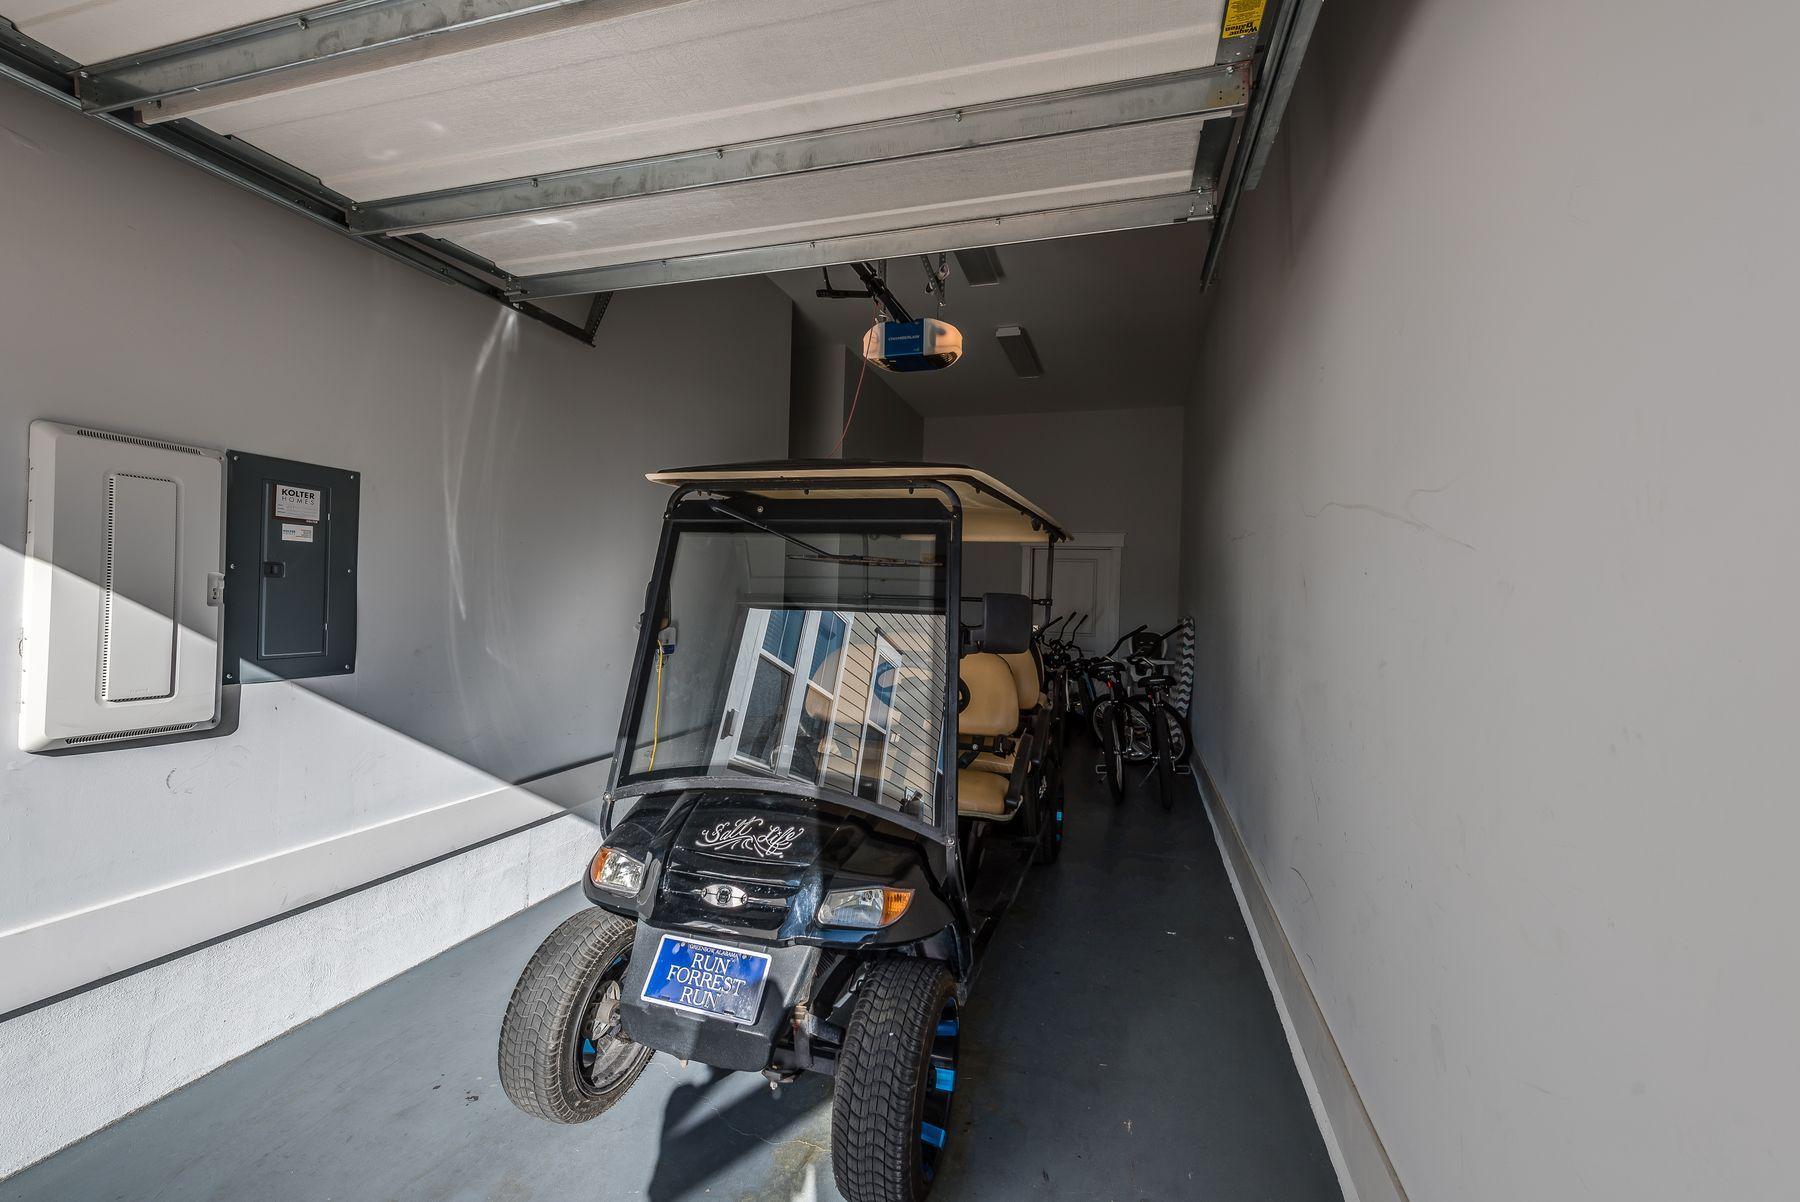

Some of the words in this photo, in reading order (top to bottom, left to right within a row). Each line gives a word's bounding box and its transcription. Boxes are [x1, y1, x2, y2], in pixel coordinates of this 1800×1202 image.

[282, 489, 315, 500] KOLTER
[282, 496, 315, 506] HOMES
[702, 816, 763, 843] Salt
[757, 825, 804, 856] Life
[691, 952, 731, 975] RUN
[667, 965, 746, 996] FORREST
[680, 986, 719, 1008] RUN
